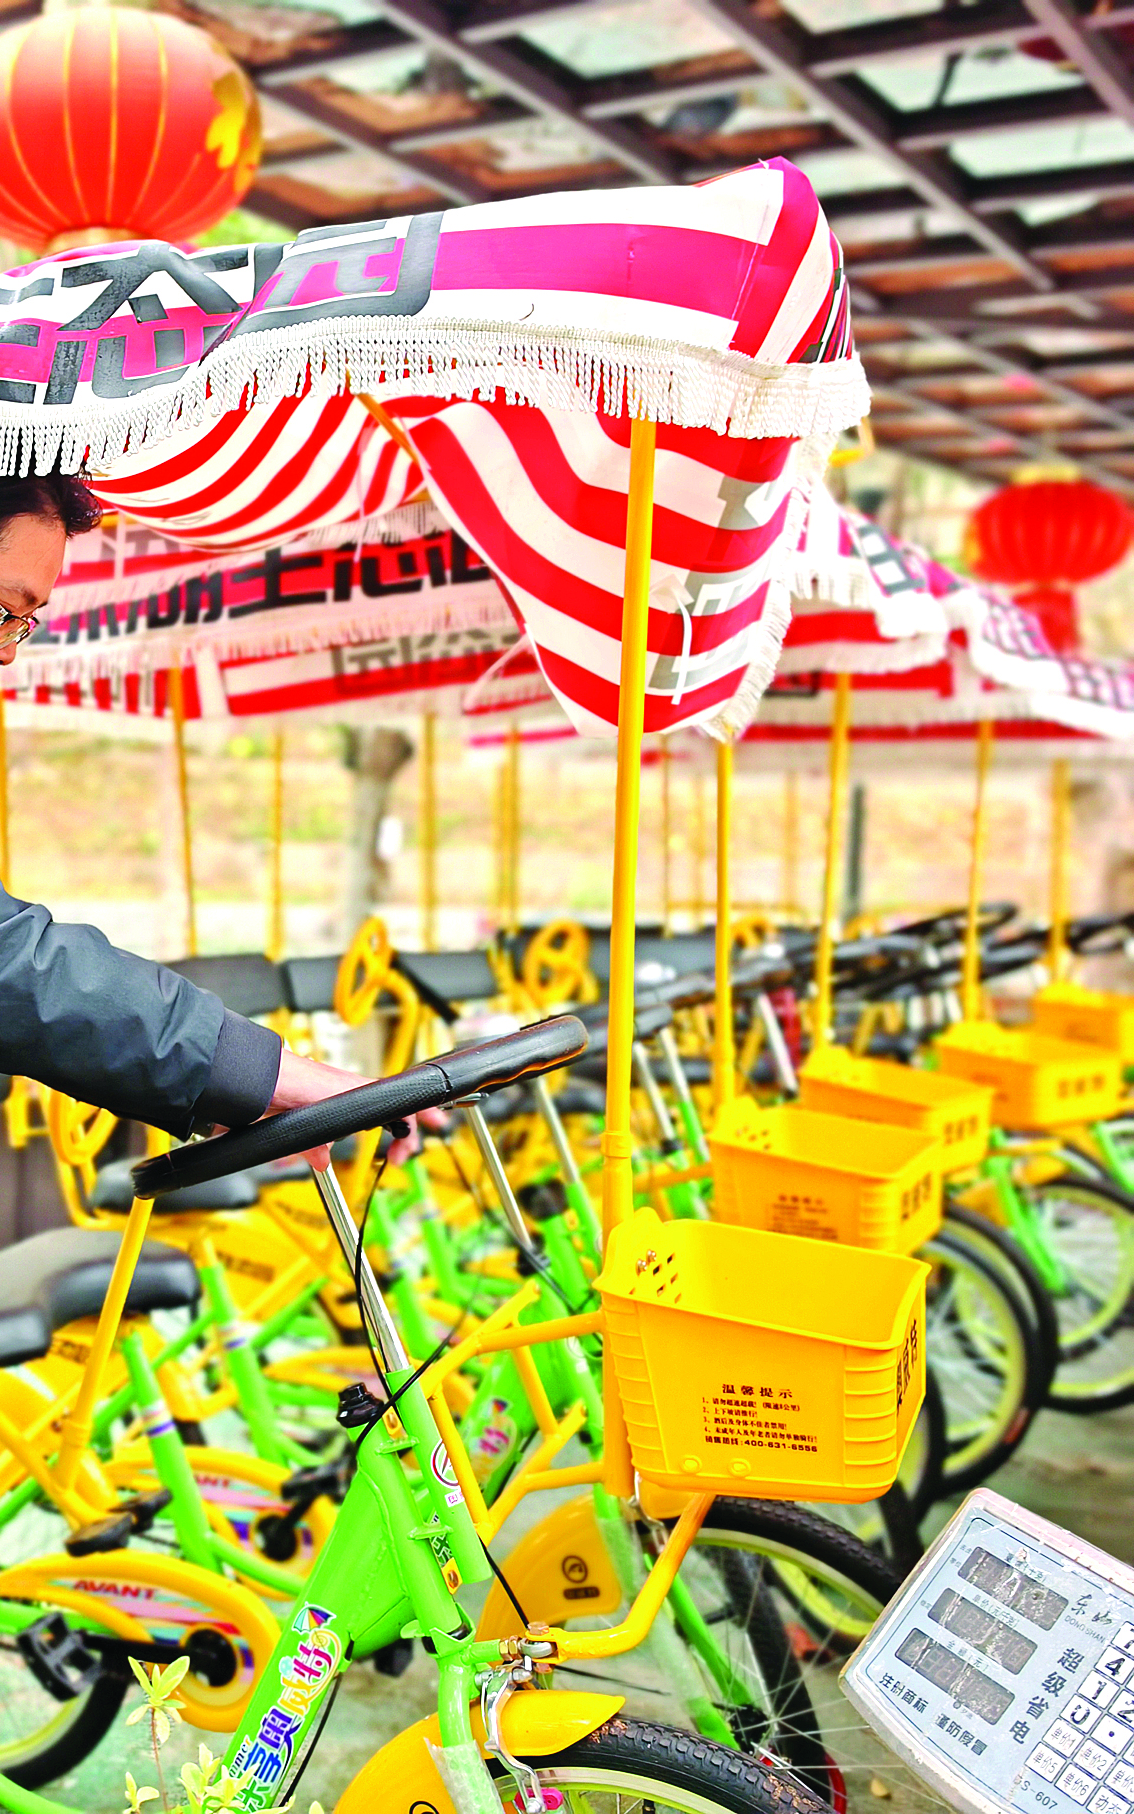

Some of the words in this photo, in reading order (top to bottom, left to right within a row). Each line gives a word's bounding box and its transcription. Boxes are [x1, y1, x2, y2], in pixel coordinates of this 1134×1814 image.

[722, 1384, 793, 1399] 温馨提示
[73, 1579, 155, 1600] AVANT
[1085, 1627, 1106, 1645] SHAN
[1105, 1657, 1126, 1676] 4
[879, 1672, 929, 1713] 注册商标
[1009, 1647, 1085, 1745] 超级省电
